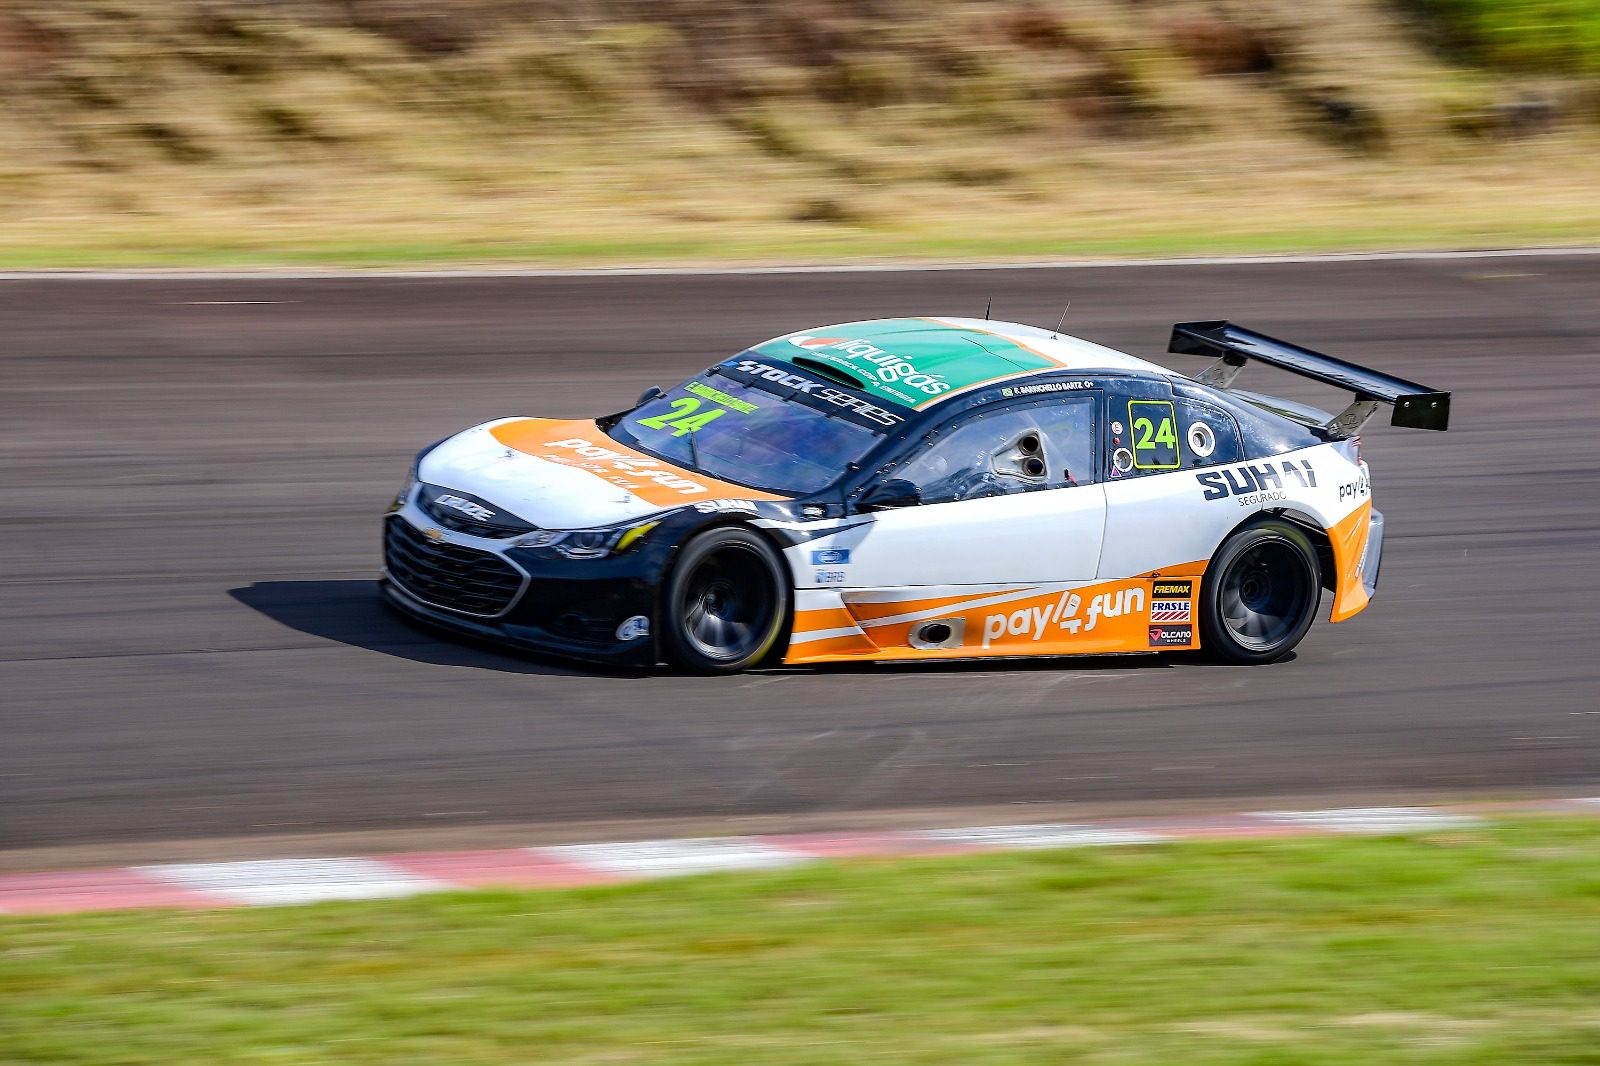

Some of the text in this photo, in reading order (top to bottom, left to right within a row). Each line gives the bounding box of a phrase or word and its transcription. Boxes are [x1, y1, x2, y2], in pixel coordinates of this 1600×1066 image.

[735, 360, 905, 426] STOCK SERIES
[636, 397, 727, 438] 24
[1133, 417, 1176, 450] 24
[1195, 459, 1318, 502] SUHAI
[1153, 585, 1191, 594] FREMAX
